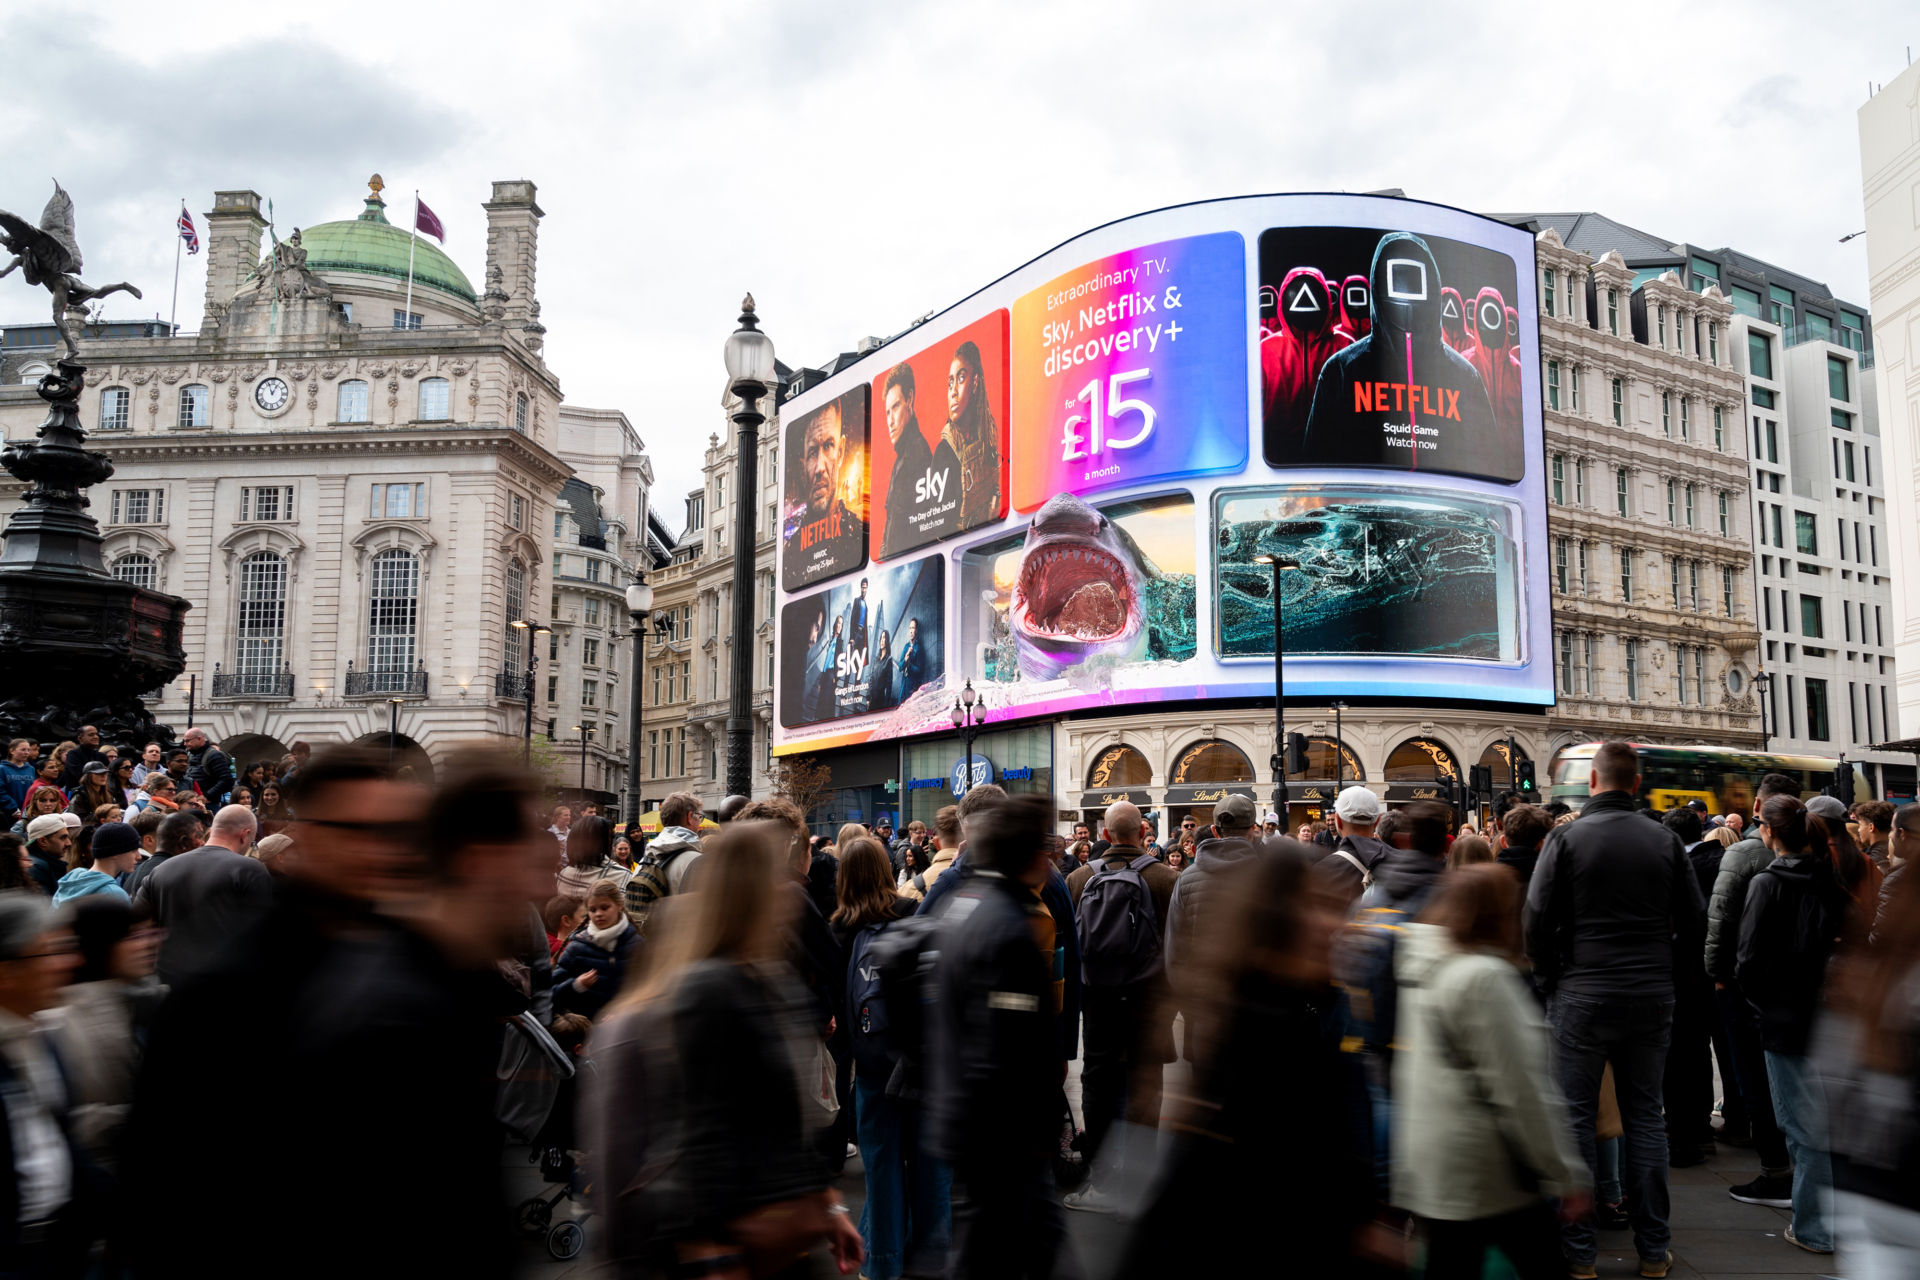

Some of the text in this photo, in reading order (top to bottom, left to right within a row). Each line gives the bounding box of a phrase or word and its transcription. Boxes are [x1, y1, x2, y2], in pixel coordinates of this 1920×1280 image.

[1047, 257, 1170, 311] Extraordinary TV.
[1042, 286, 1182, 348] Sky, Netflix &
[1044, 320, 1183, 378] discovery+
[1065, 398, 1076, 410] for
[1354, 381, 1461, 422] NETFLIX
[1061, 367, 1158, 462] £15
[1383, 422, 1439, 437] Squid Game
[1386, 436, 1437, 450] Watch now
[1084, 464, 1120, 481] a month
[519, 474, 528, 487] LIFE
[915, 467, 949, 504] sky
[909, 499, 956, 525] The Day of the Jackal
[800, 511, 842, 552] NETFLIX
[919, 518, 945, 533] Watch now
[806, 562, 820, 573] Coming
[836, 643, 867, 681] sky
[835, 686, 848, 696] Gangs
[852, 682, 869, 693] London
[840, 695, 863, 707] Watch now
[1002, 766, 1033, 781] beauty
[907, 777, 944, 792] pharmacy
[1191, 790, 1221, 801] Lindt
[1301, 787, 1325, 799] Lin
[859, 965, 882, 982] VA
